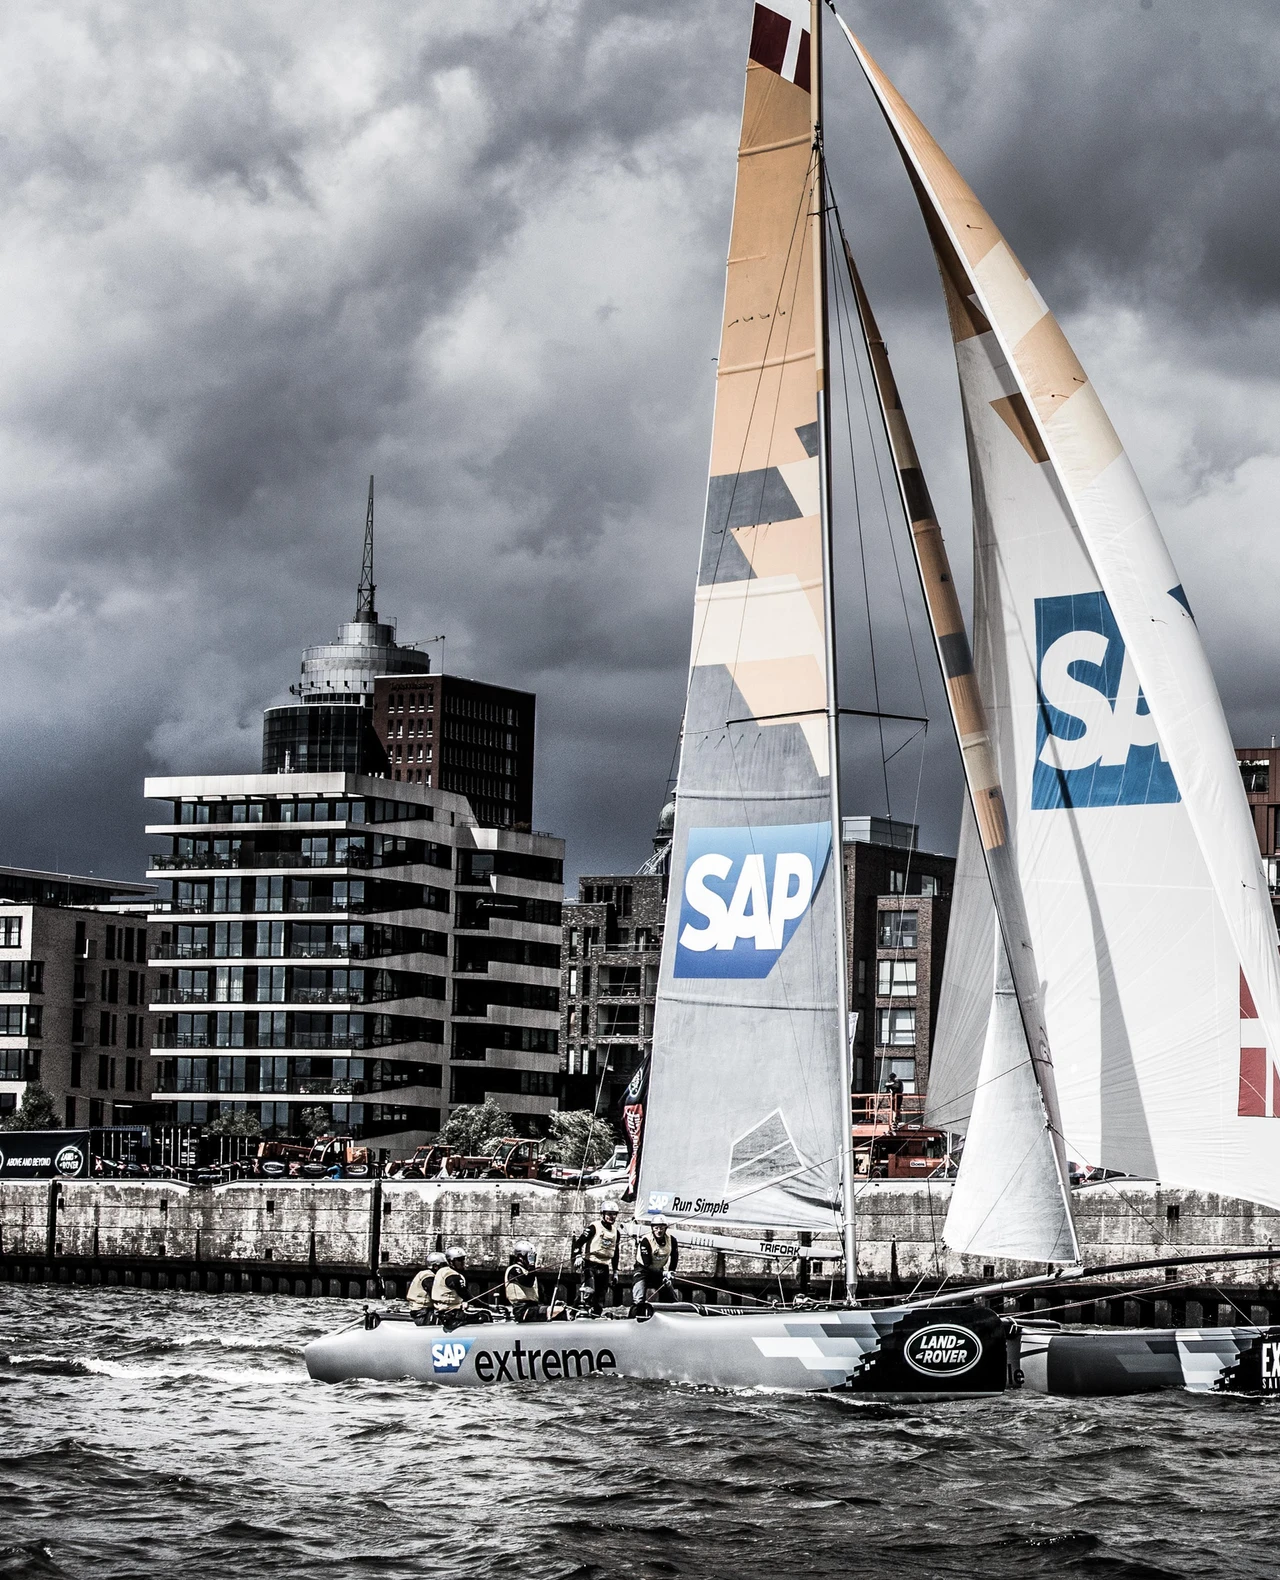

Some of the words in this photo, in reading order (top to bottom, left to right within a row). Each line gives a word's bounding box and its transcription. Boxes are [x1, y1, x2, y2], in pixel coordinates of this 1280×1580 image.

[1038, 630, 1171, 770] SA
[679, 852, 813, 952] SAP
[22, 1158, 32, 1166] AND
[648, 1194, 669, 1210] SAP
[672, 1197, 692, 1211] Run
[694, 1198, 729, 1216] Simple
[760, 1242, 800, 1257] TRIFORK
[920, 1335, 957, 1349] LAND
[432, 1343, 465, 1367] SAP
[475, 1340, 616, 1382] extreme
[923, 1349, 967, 1363] ROVER
